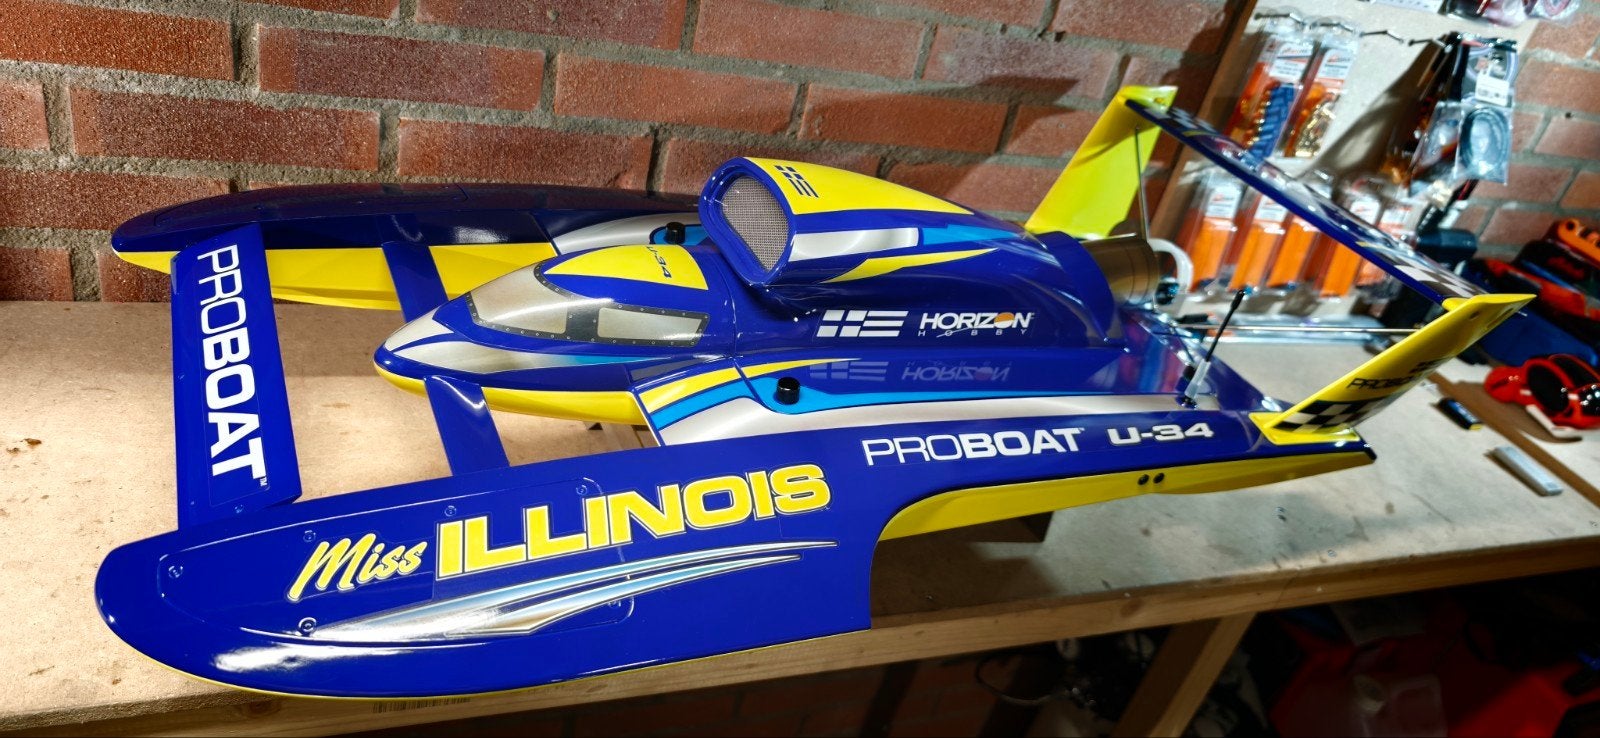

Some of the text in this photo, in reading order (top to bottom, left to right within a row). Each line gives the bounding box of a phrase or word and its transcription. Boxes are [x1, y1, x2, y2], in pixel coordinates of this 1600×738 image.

[646, 245, 672, 278] U-34
[917, 329, 1027, 337] HOBBY
[919, 311, 1031, 329] HORIZON
[197, 243, 267, 479] PROBOAT
[862, 422, 1215, 466] PROBOAT U-34
[286, 463, 832, 602] Miss ILLINOIS
